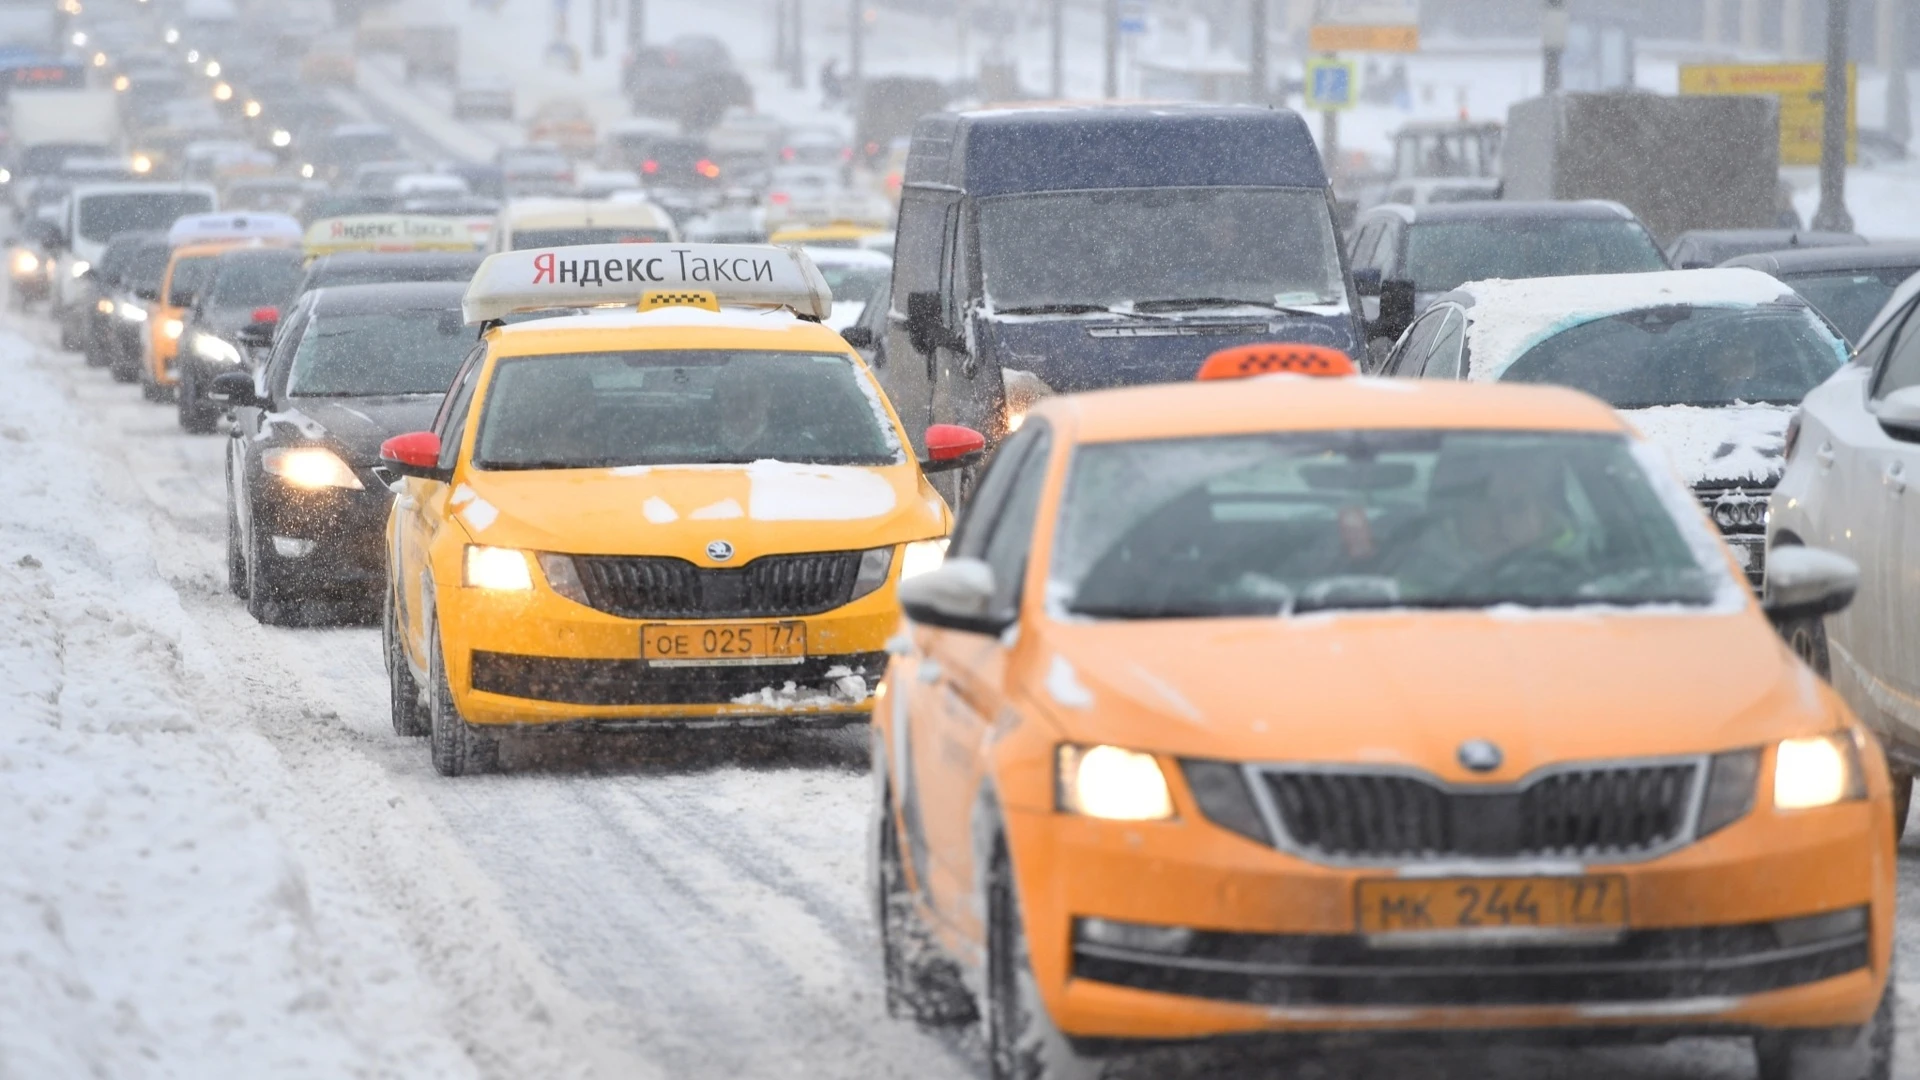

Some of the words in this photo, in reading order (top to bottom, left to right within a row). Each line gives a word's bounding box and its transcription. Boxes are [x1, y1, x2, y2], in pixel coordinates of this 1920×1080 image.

[331, 219, 398, 239] Яндекс
[532, 253, 664, 287] Яндекс
[671, 250, 773, 282] Такси
[657, 635, 689, 655] ОЕ
[703, 629, 753, 654] 025
[769, 627, 794, 645] 77
[1456, 883, 1541, 927] 244
